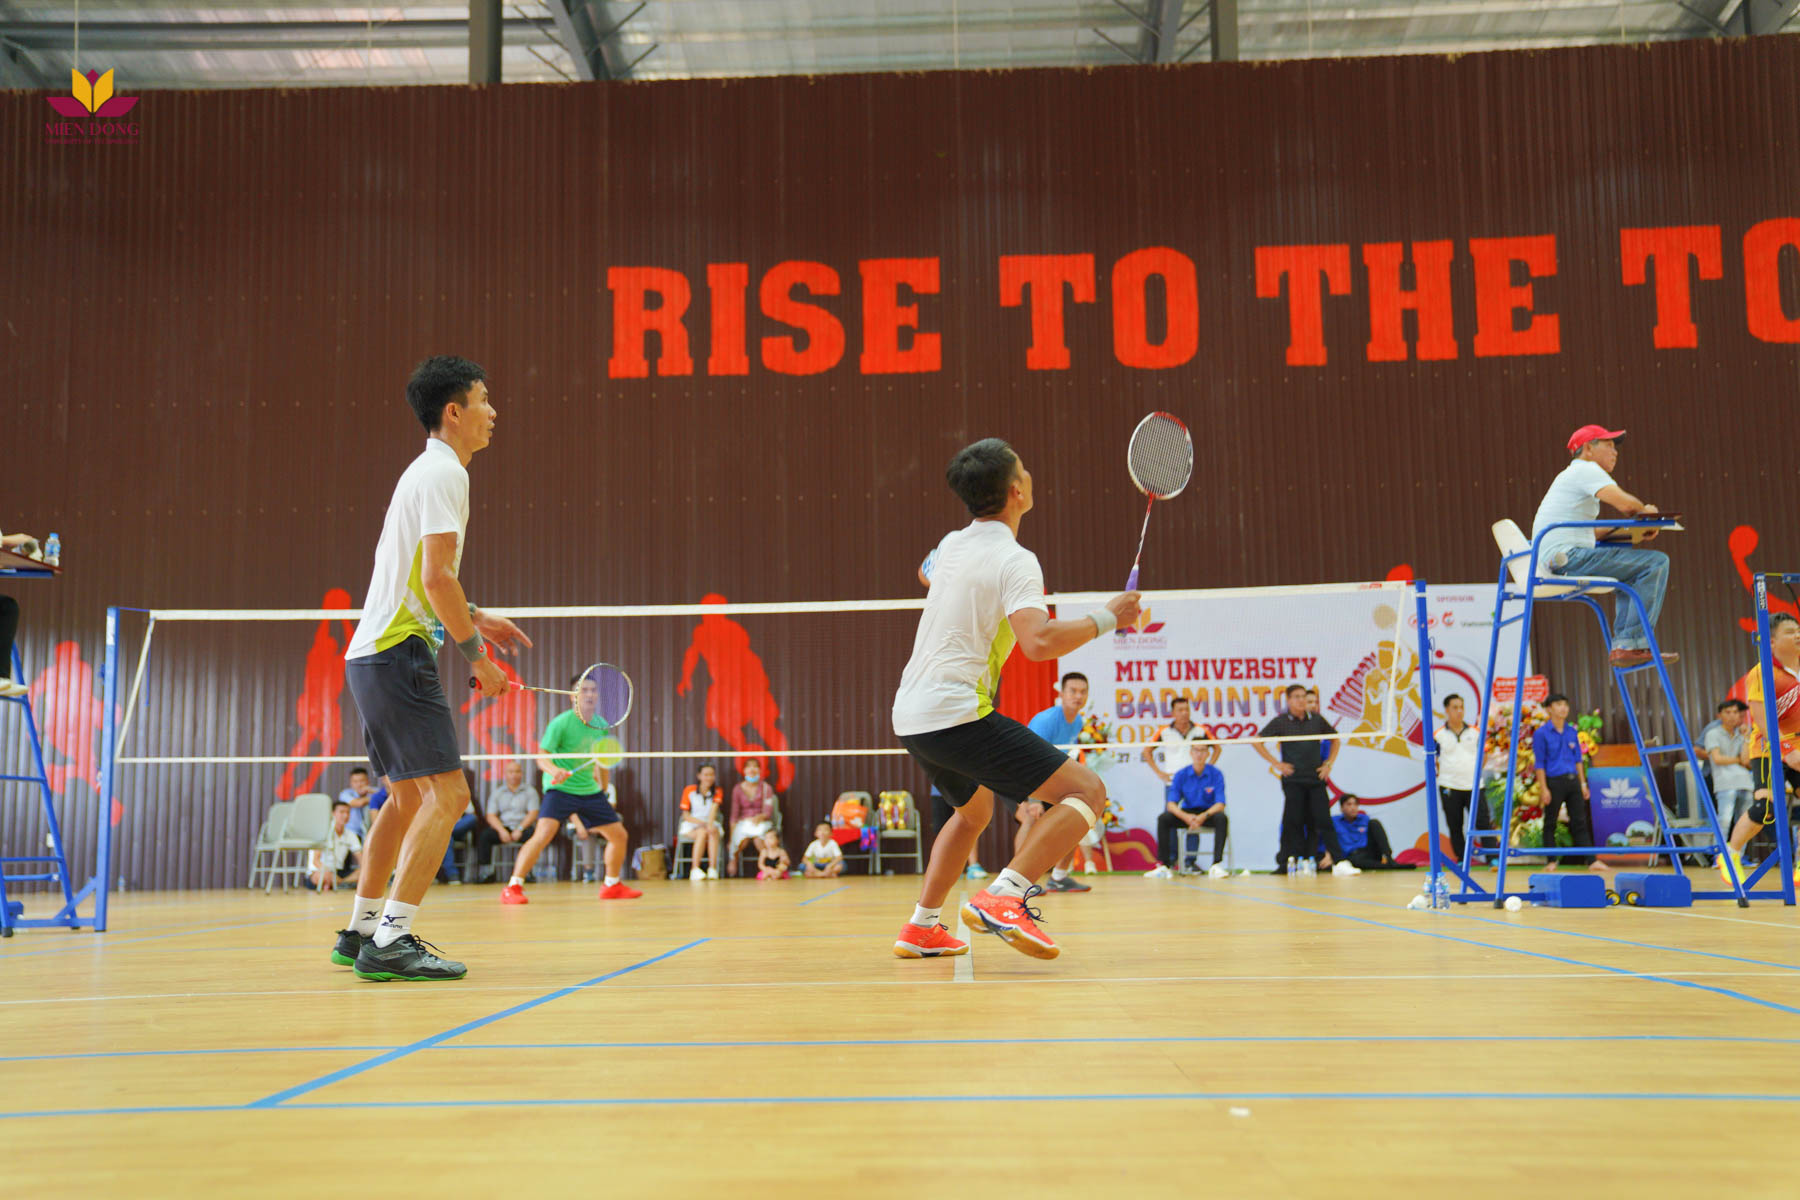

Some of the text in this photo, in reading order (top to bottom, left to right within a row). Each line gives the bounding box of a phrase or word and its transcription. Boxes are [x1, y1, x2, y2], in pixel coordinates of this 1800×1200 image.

[607, 257, 942, 379] RISE
[998, 246, 1200, 371] TO
[1254, 234, 1561, 367] THE
[1115, 658, 1317, 682] MIT UNIVERSITY
[1115, 685, 1320, 719] BADMINTO
